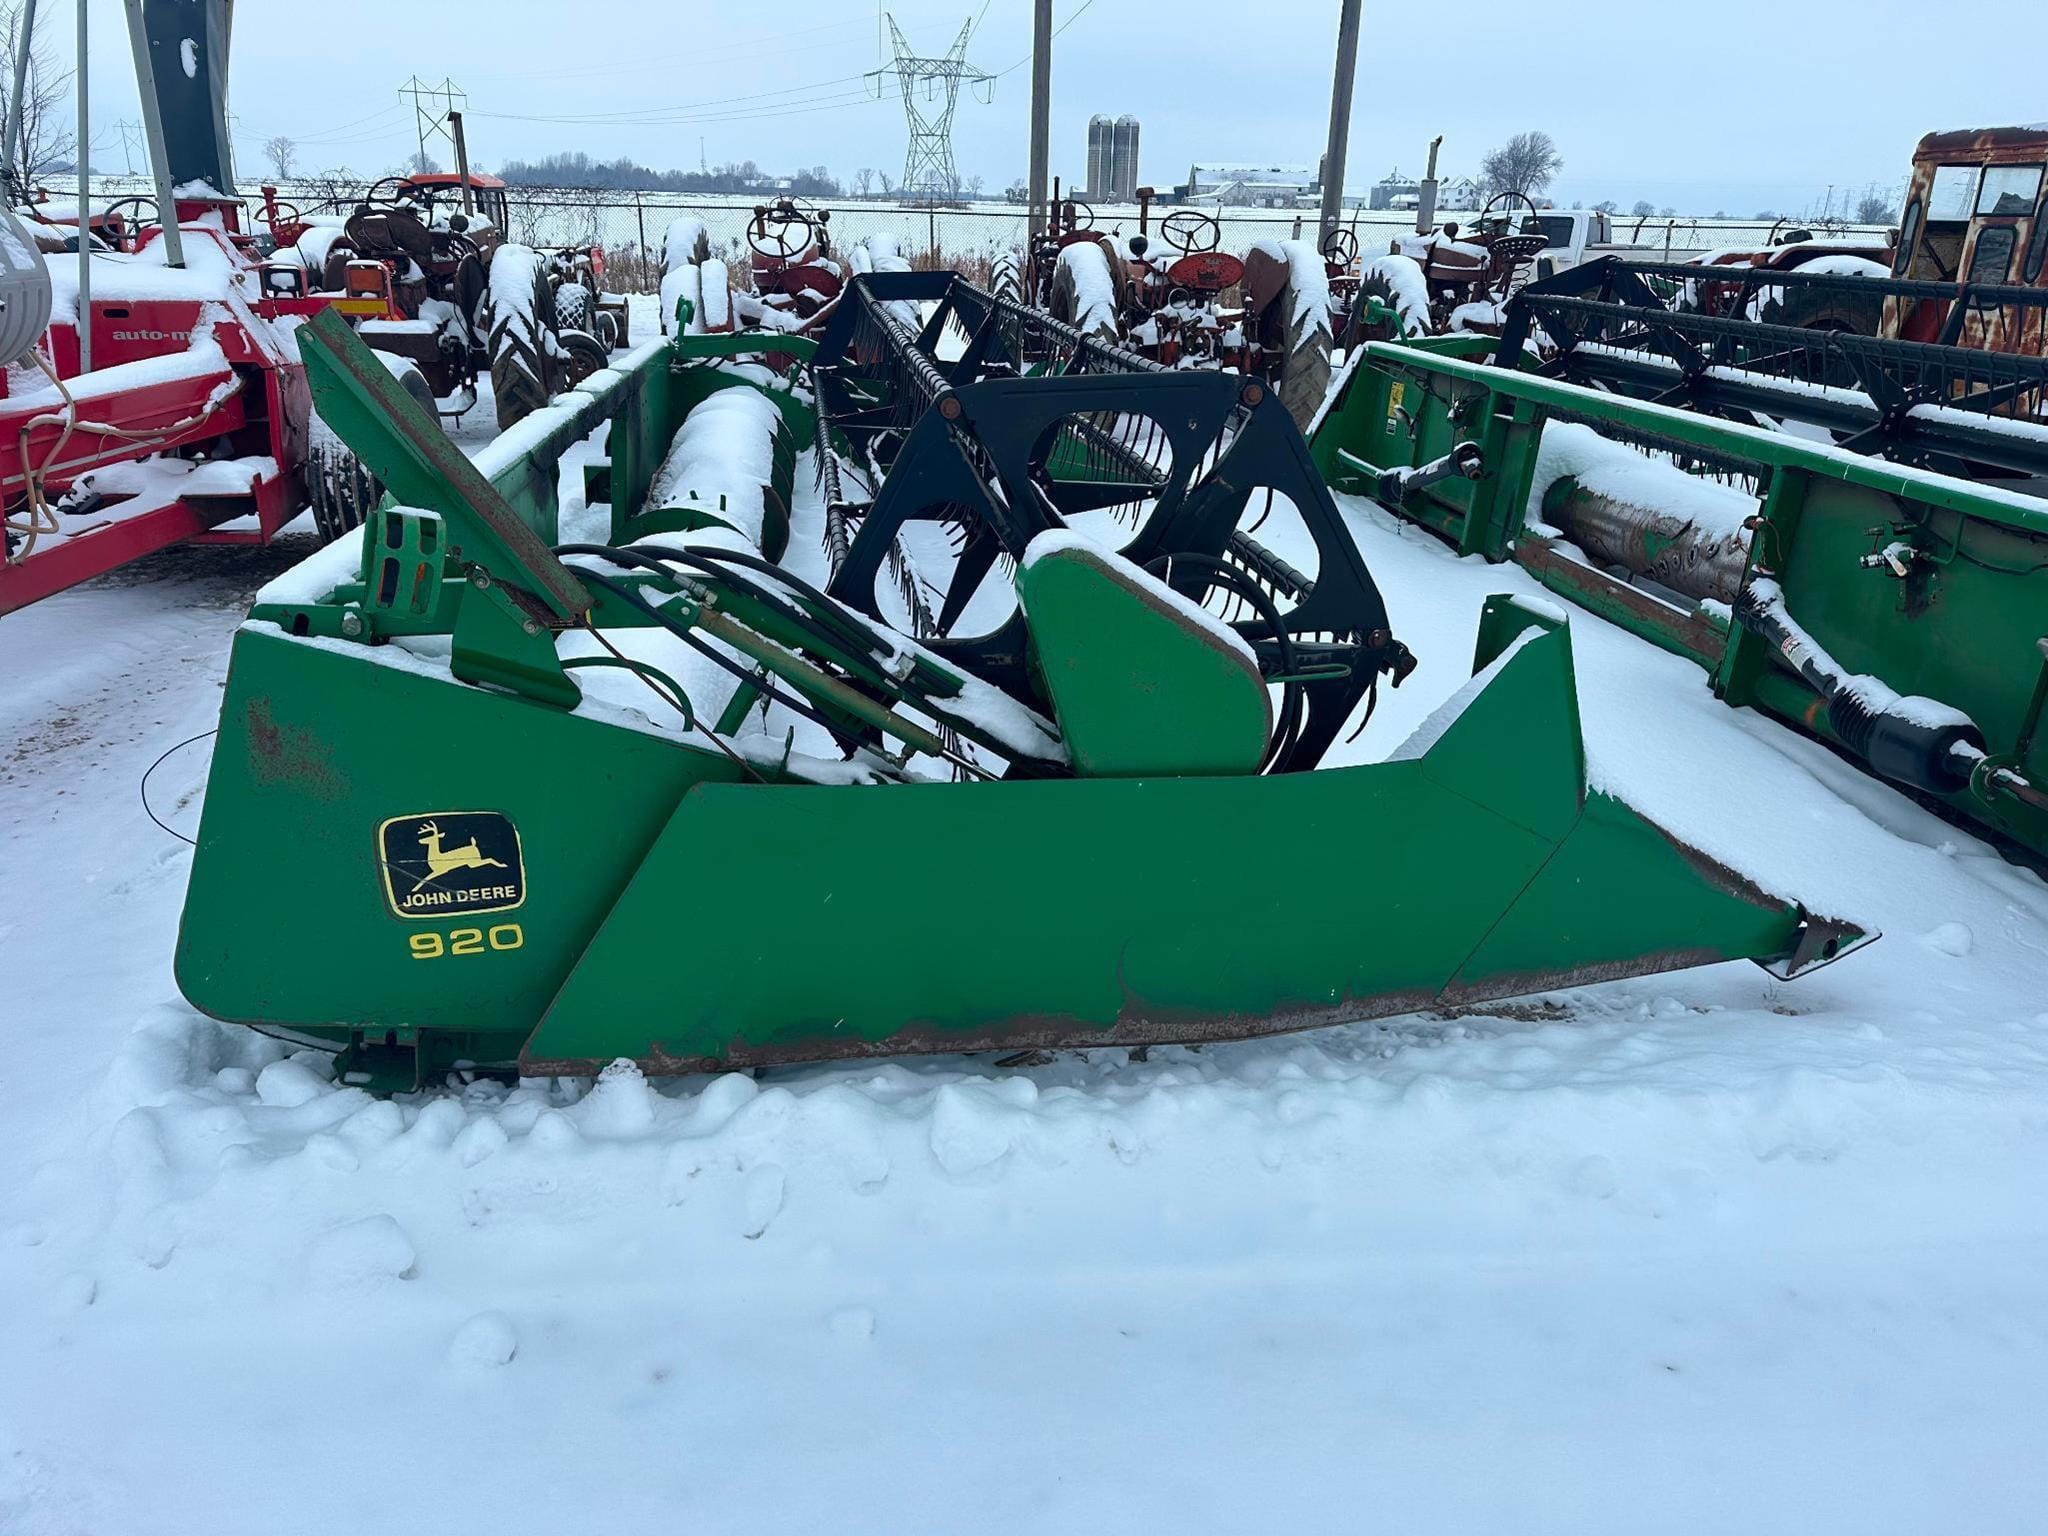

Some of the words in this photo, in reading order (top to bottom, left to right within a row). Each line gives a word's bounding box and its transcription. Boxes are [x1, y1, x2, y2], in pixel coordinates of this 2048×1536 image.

[112, 329, 222, 341] auto-m
[403, 891, 452, 908] JOHN
[456, 885, 517, 902] DEERE
[409, 923, 524, 960] 920
